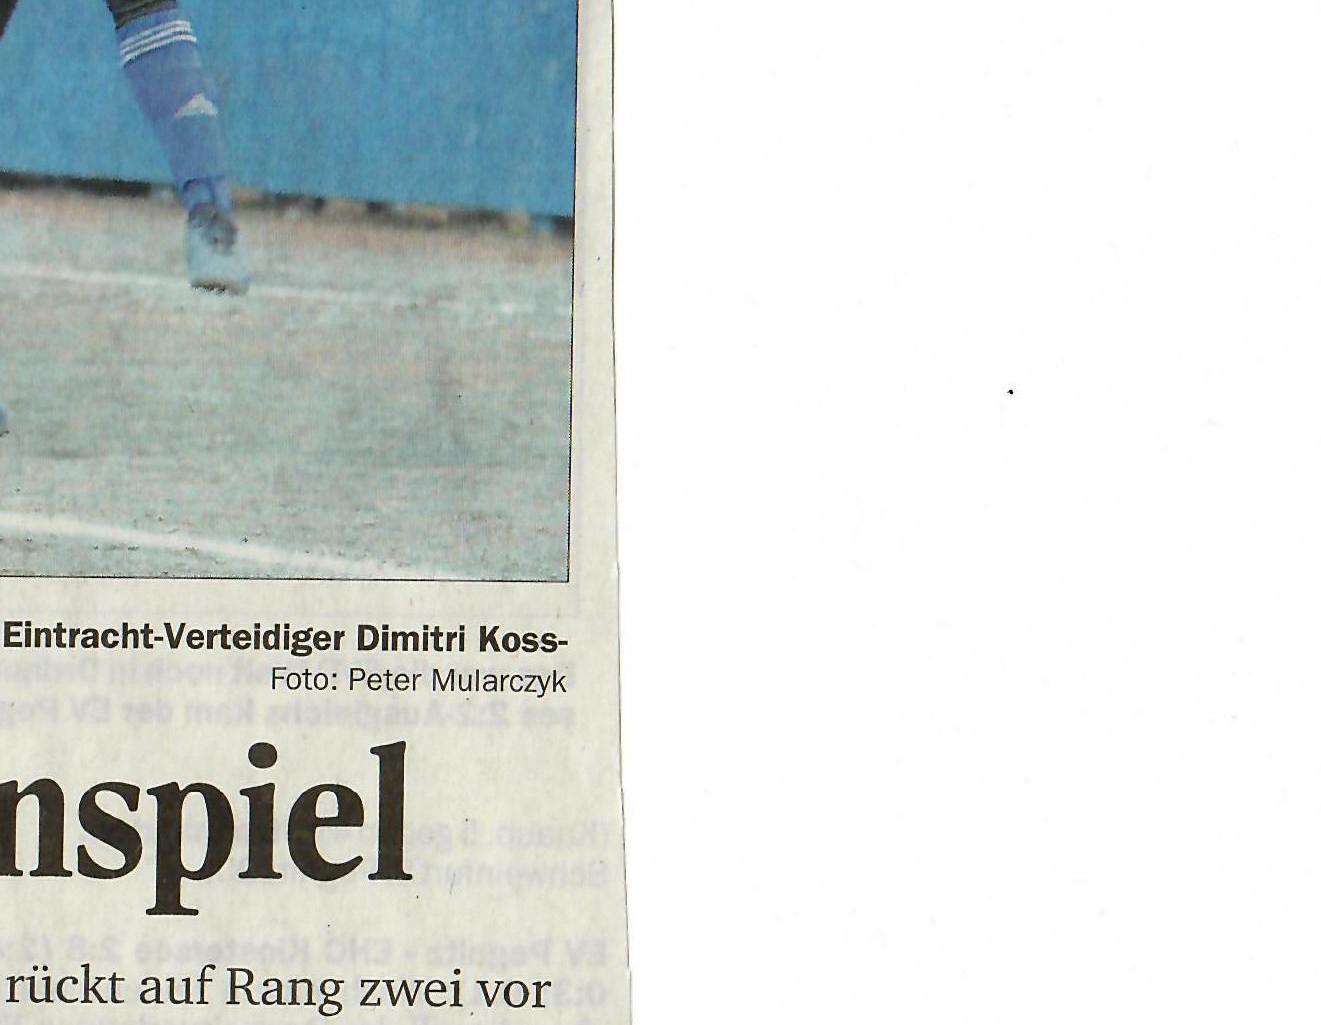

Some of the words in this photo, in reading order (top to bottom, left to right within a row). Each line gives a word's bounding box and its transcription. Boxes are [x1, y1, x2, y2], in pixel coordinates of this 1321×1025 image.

[3, 620, 346, 657] Eintracht-Verteidiger
[357, 624, 465, 652] Dimitri
[479, 625, 569, 653] Koss-
[271, 666, 337, 691] Foto:
[349, 667, 423, 692] Peter
[432, 668, 567, 698] Mularczyk
[5, 963, 125, 1004] rückt
[139, 963, 217, 1005] auf
[225, 967, 345, 1017] Rang
[359, 968, 464, 1008] zwei
[475, 980, 552, 1009] vor
